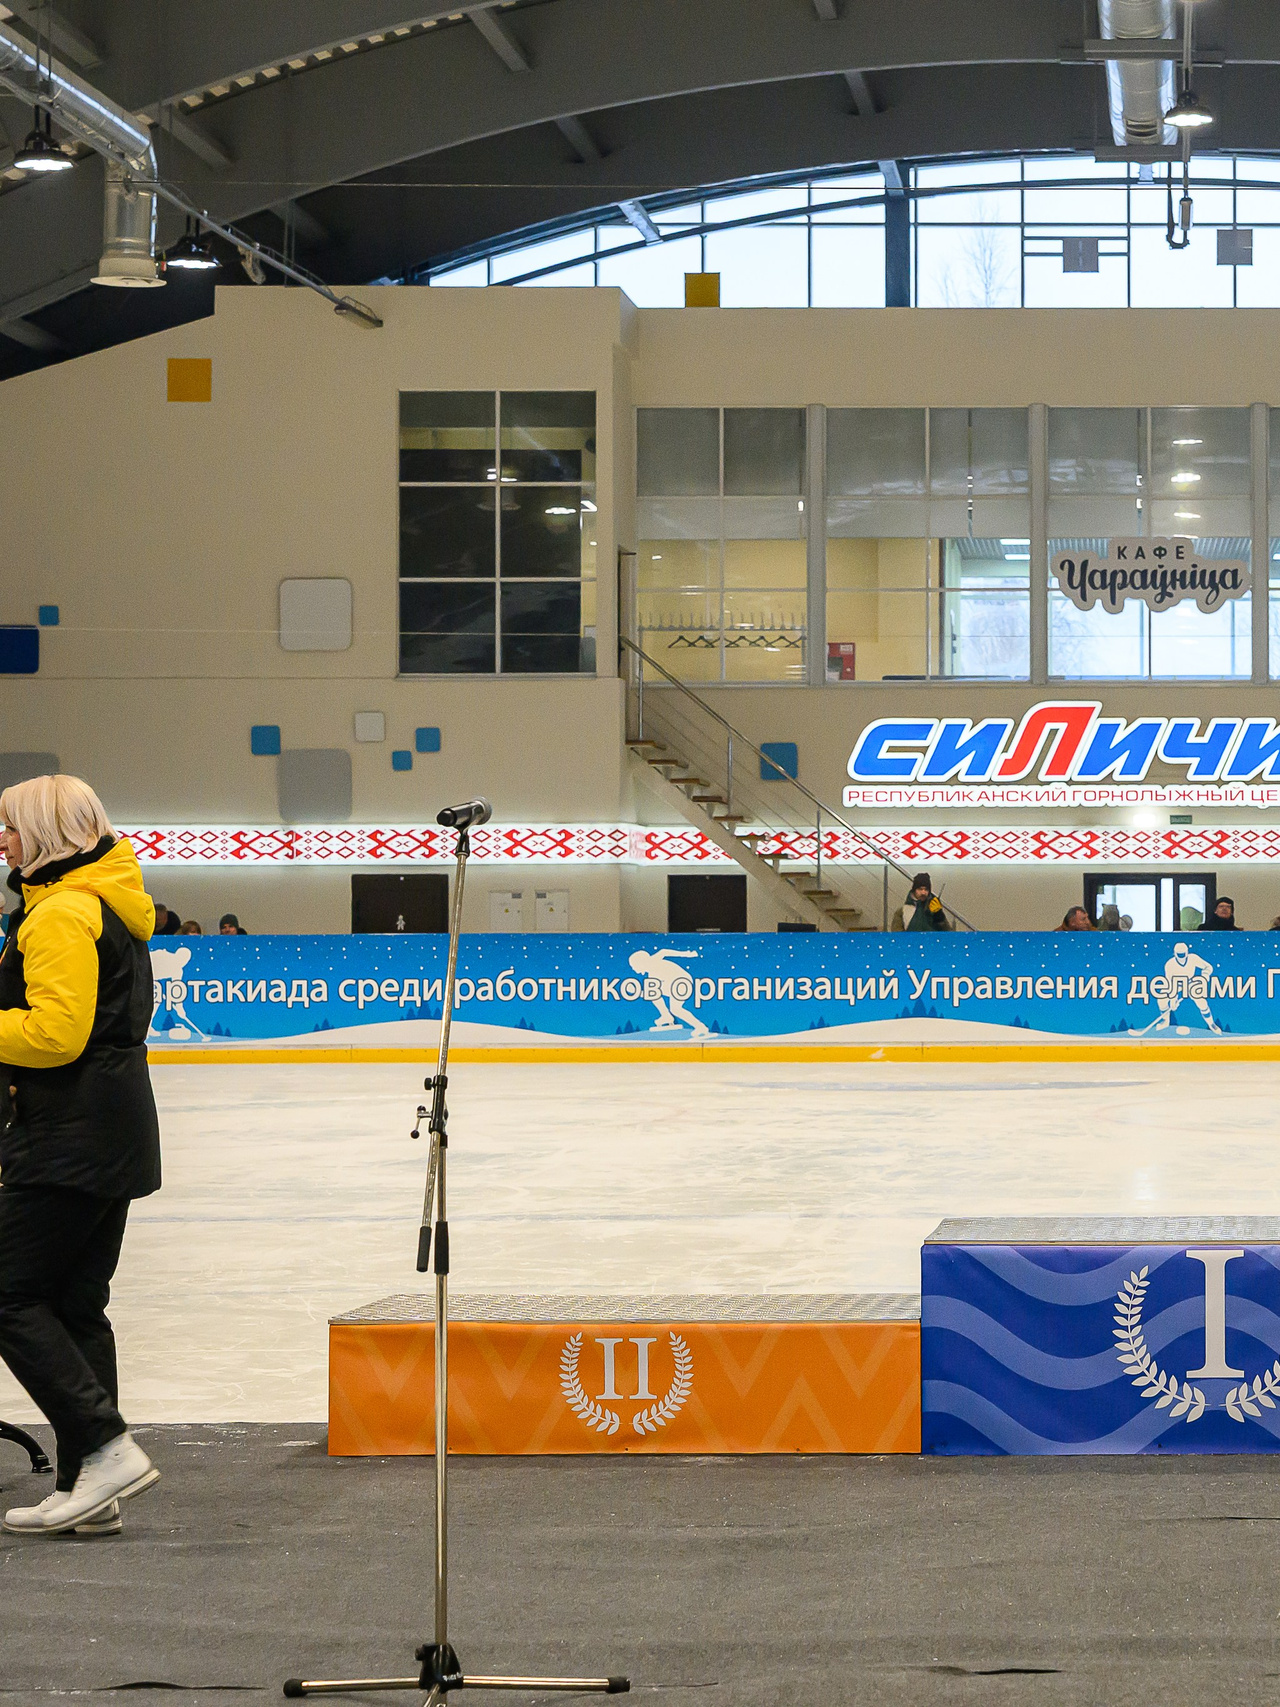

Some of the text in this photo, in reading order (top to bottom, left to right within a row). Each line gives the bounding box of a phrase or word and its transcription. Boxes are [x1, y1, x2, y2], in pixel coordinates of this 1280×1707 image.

[1117, 545, 1185, 560] КАФЕ
[1059, 559, 1243, 605] Чараўніца
[847, 786, 1067, 802] РЕСПУБЛИКАНСКИЙ
[1072, 785, 1244, 802] ГОРНОЛЫЖНЫЙ
[338, 978, 444, 1009] среди
[453, 970, 662, 1009] работников
[670, 969, 899, 1007] организаций
[907, 969, 1118, 1007] Управления
[1127, 976, 1257, 1004] делами
[594, 1337, 658, 1400] II
